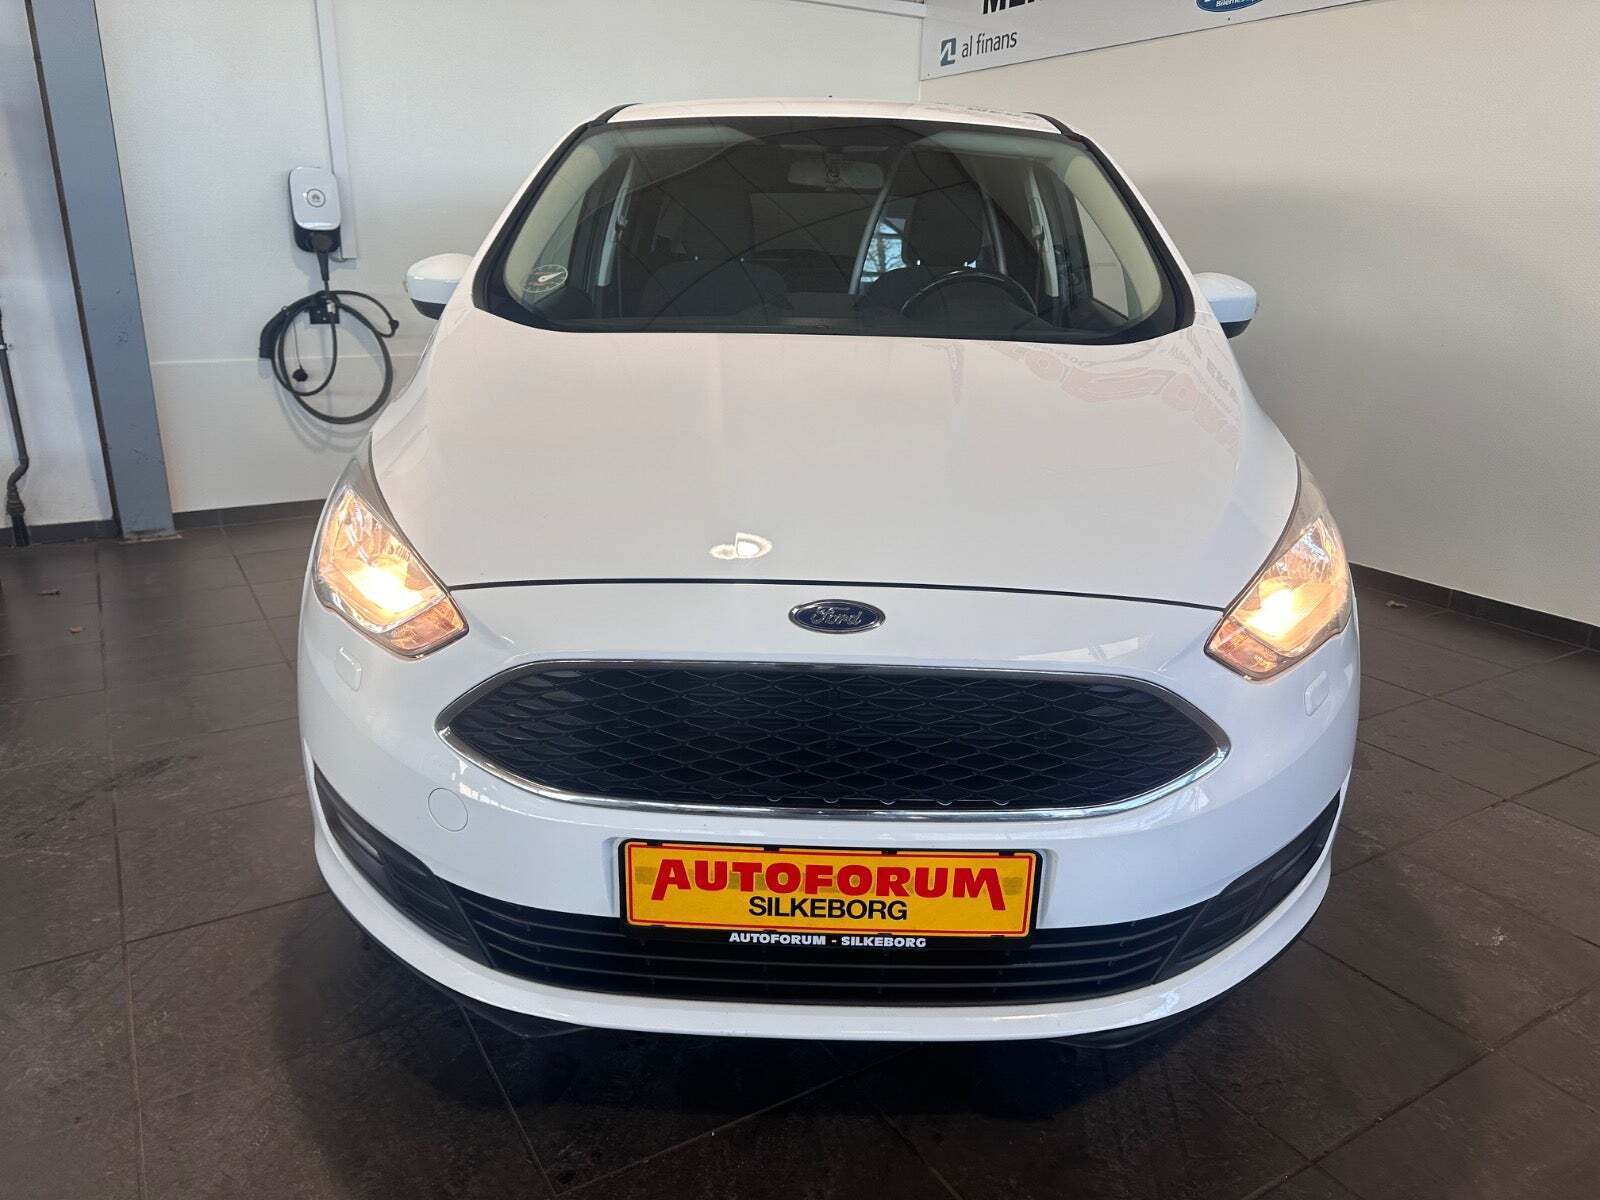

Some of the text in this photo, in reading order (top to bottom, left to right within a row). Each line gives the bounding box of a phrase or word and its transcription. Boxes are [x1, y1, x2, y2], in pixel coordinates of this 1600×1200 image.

[961, 32, 1018, 58] al finans
[810, 606, 863, 625] Ford
[651, 859, 1006, 910] AUTOFORUM
[748, 896, 908, 920] SILKEBORG
[729, 932, 826, 945] AUTOFORUM
[841, 936, 927, 948] SILKEBORG
